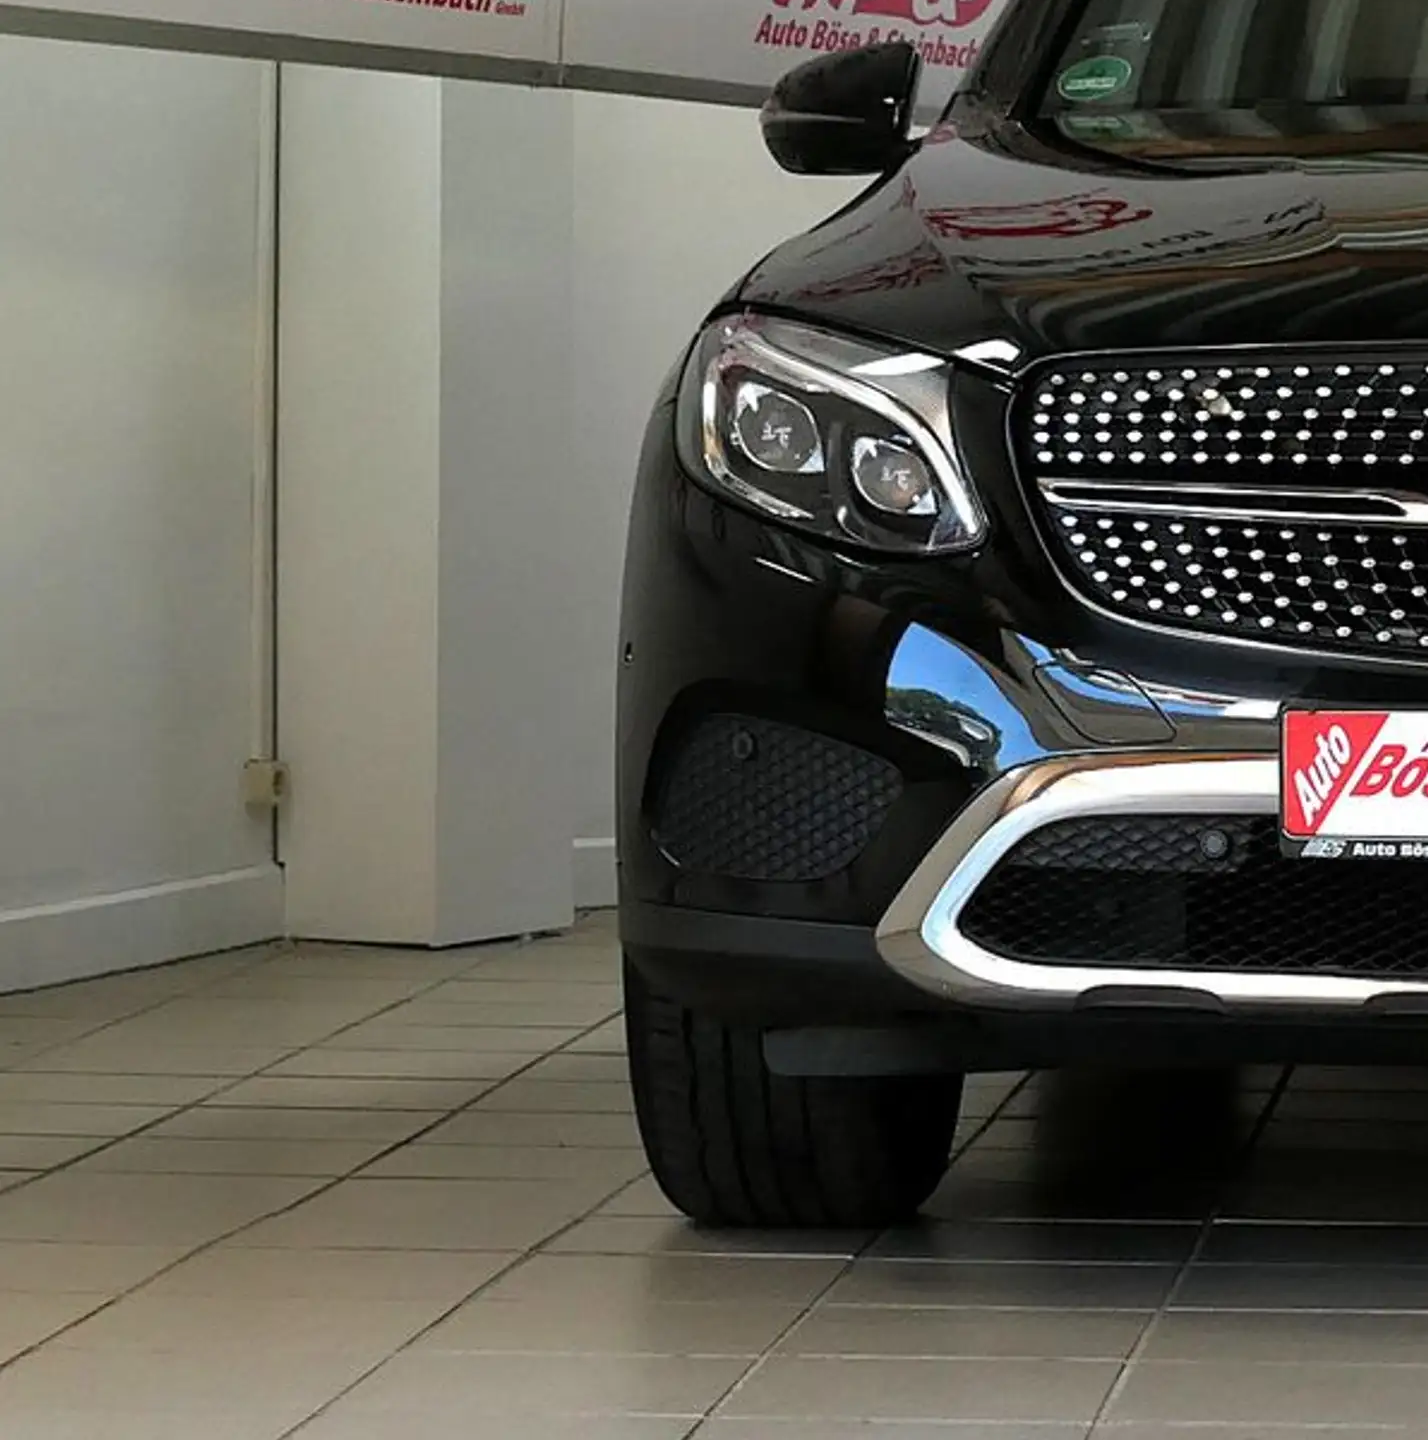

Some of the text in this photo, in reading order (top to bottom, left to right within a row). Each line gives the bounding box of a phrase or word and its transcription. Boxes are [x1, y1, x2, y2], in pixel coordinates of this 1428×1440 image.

[754, 13, 807, 47] Auto
[1293, 724, 1351, 827] Auto
[1352, 842, 1397, 857] Auto
